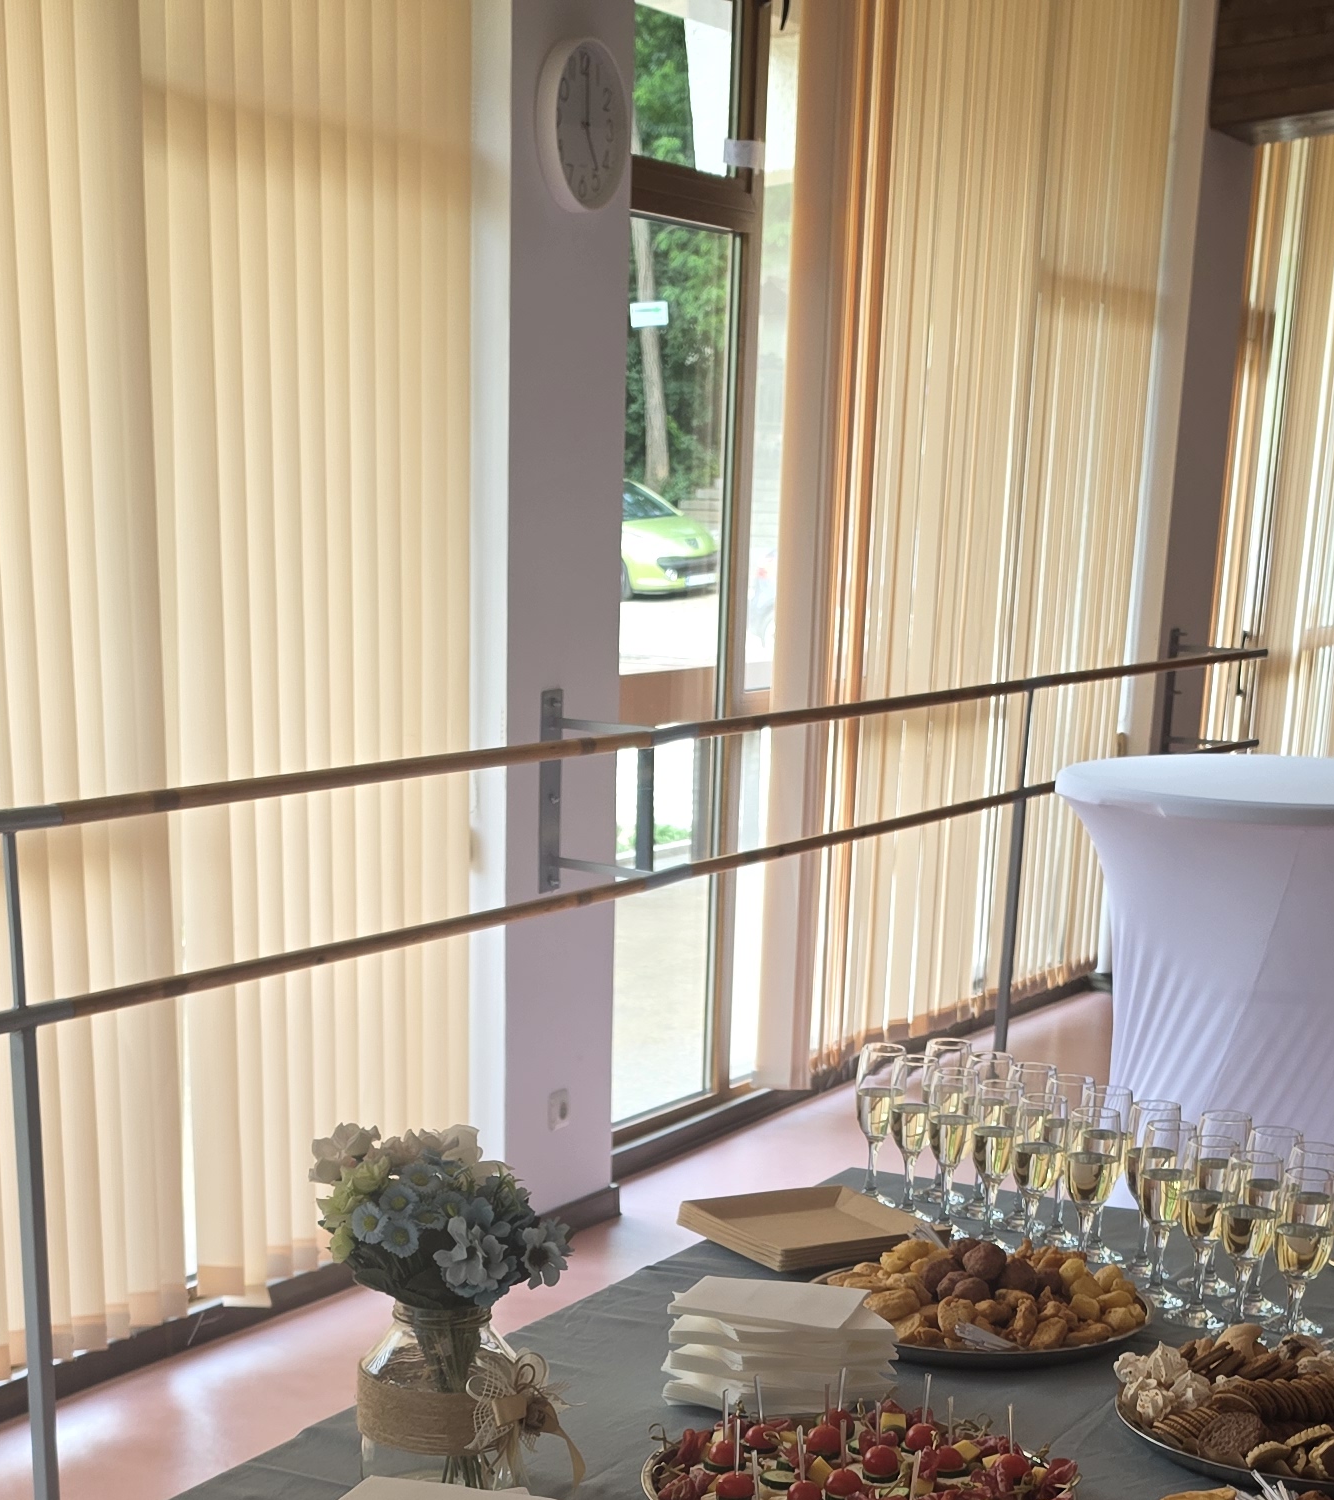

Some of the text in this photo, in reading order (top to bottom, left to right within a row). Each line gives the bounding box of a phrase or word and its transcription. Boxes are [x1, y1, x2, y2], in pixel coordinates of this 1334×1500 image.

[602, 87, 613, 113] 2
[605, 118, 615, 143] 3
[578, 175, 588, 199] 6
[590, 168, 602, 193] 5
